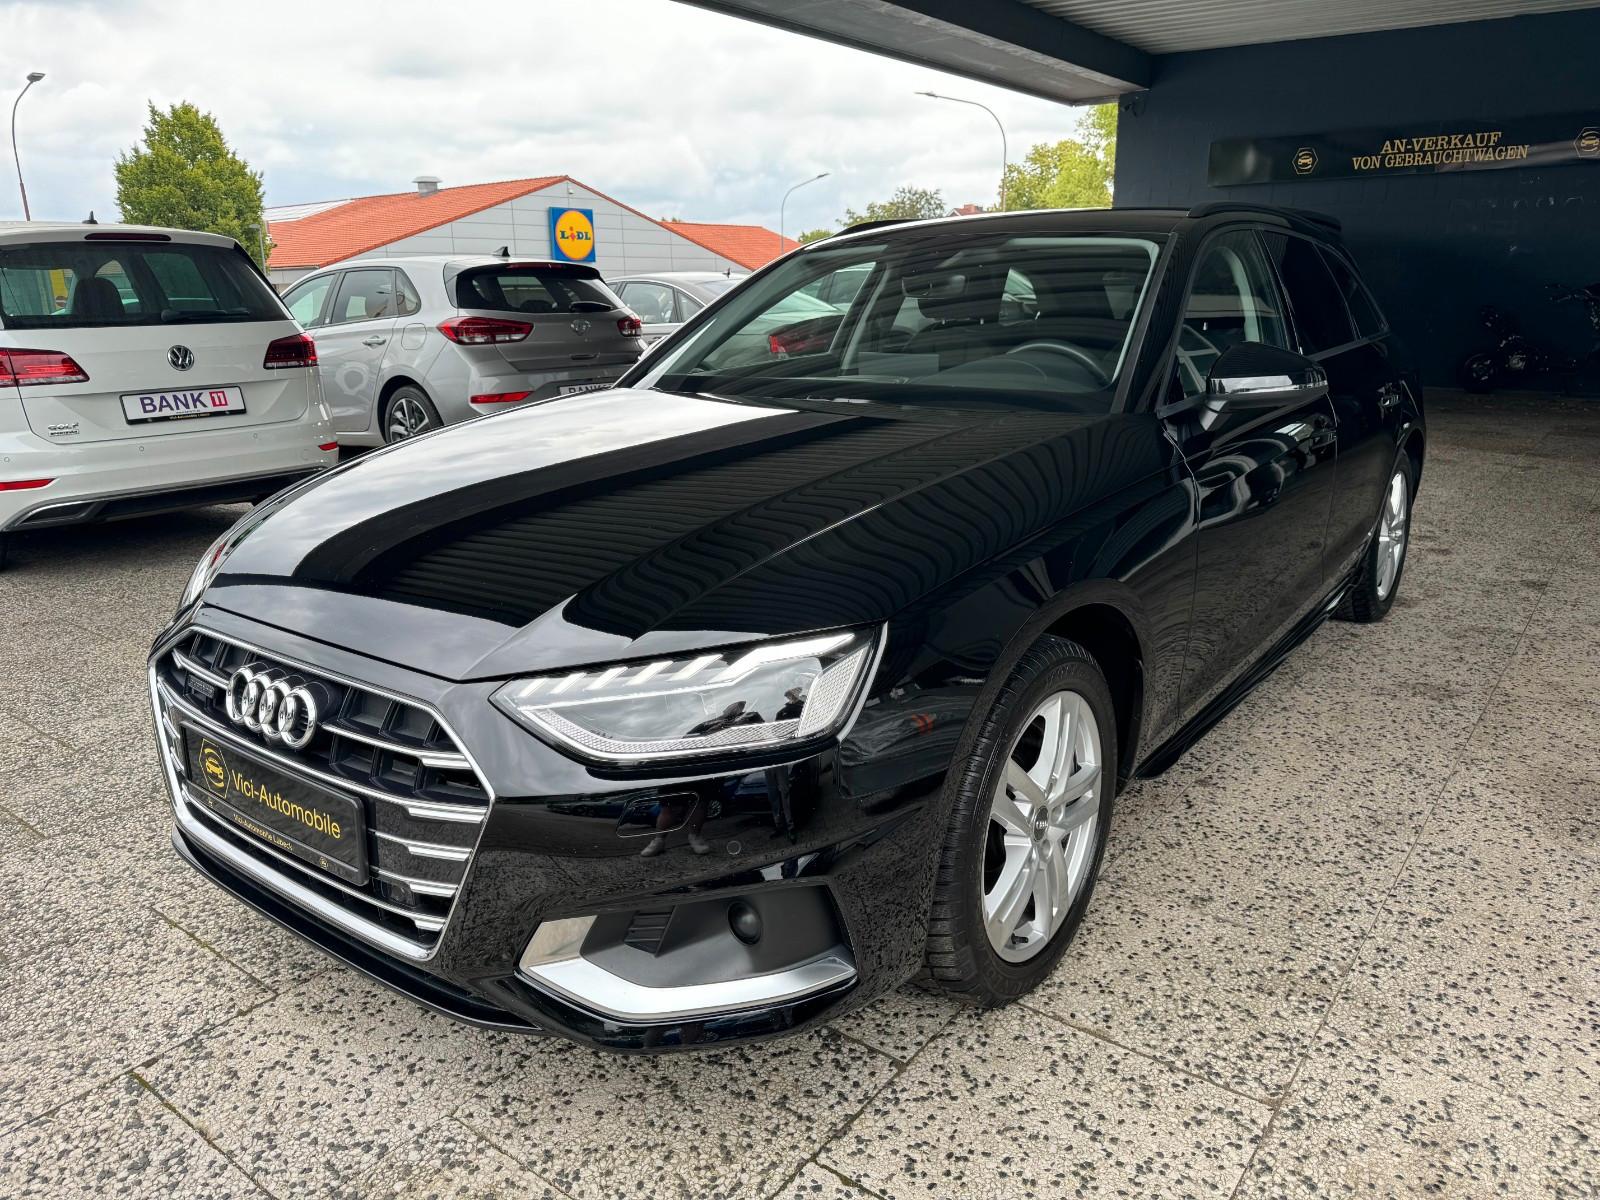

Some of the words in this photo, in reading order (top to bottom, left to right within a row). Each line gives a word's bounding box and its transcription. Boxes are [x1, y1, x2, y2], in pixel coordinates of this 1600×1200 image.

[1380, 131, 1502, 155] AN-VERKAUF
[1352, 155, 1382, 170] VON
[1385, 144, 1530, 168] GEBRAUCHTWAGEN
[139, 391, 208, 414] BANK
[210, 391, 226, 406] 11
[231, 769, 341, 839] Vici-Automobile
